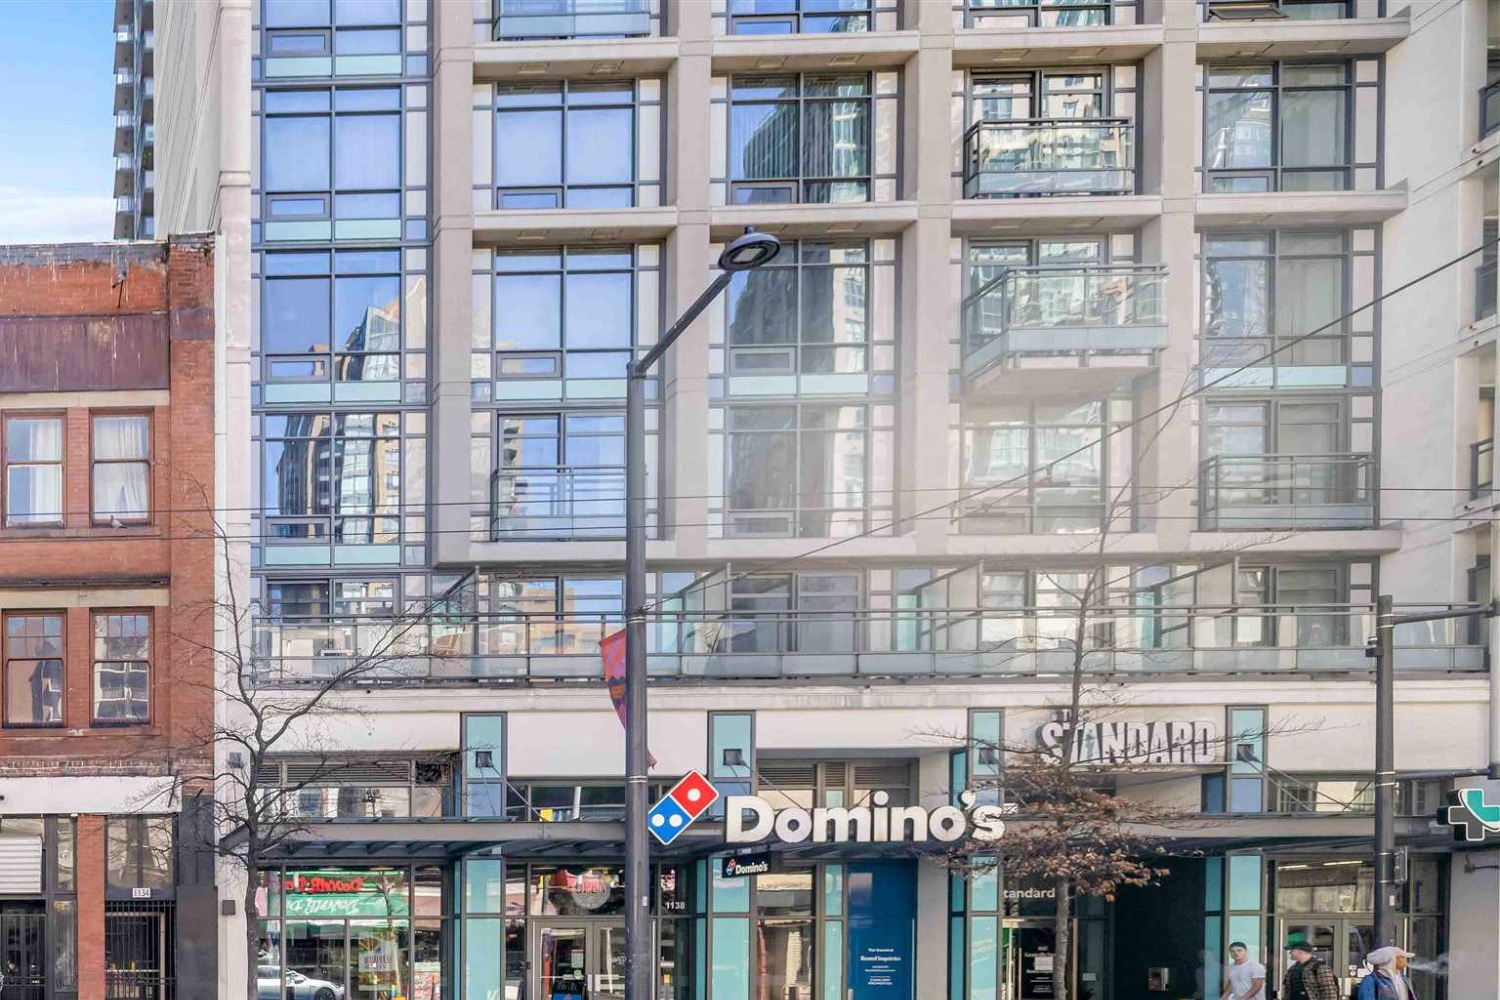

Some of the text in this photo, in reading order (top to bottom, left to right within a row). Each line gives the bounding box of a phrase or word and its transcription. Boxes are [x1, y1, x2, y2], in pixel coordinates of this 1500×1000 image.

[1038, 721, 1217, 765] STANDARD
[725, 789, 1006, 844] Domino's
[735, 861, 768, 875] Domino's
[134, 888, 150, 897] 1134
[1003, 888, 1056, 898] tandard
[665, 901, 685, 909] 1138
